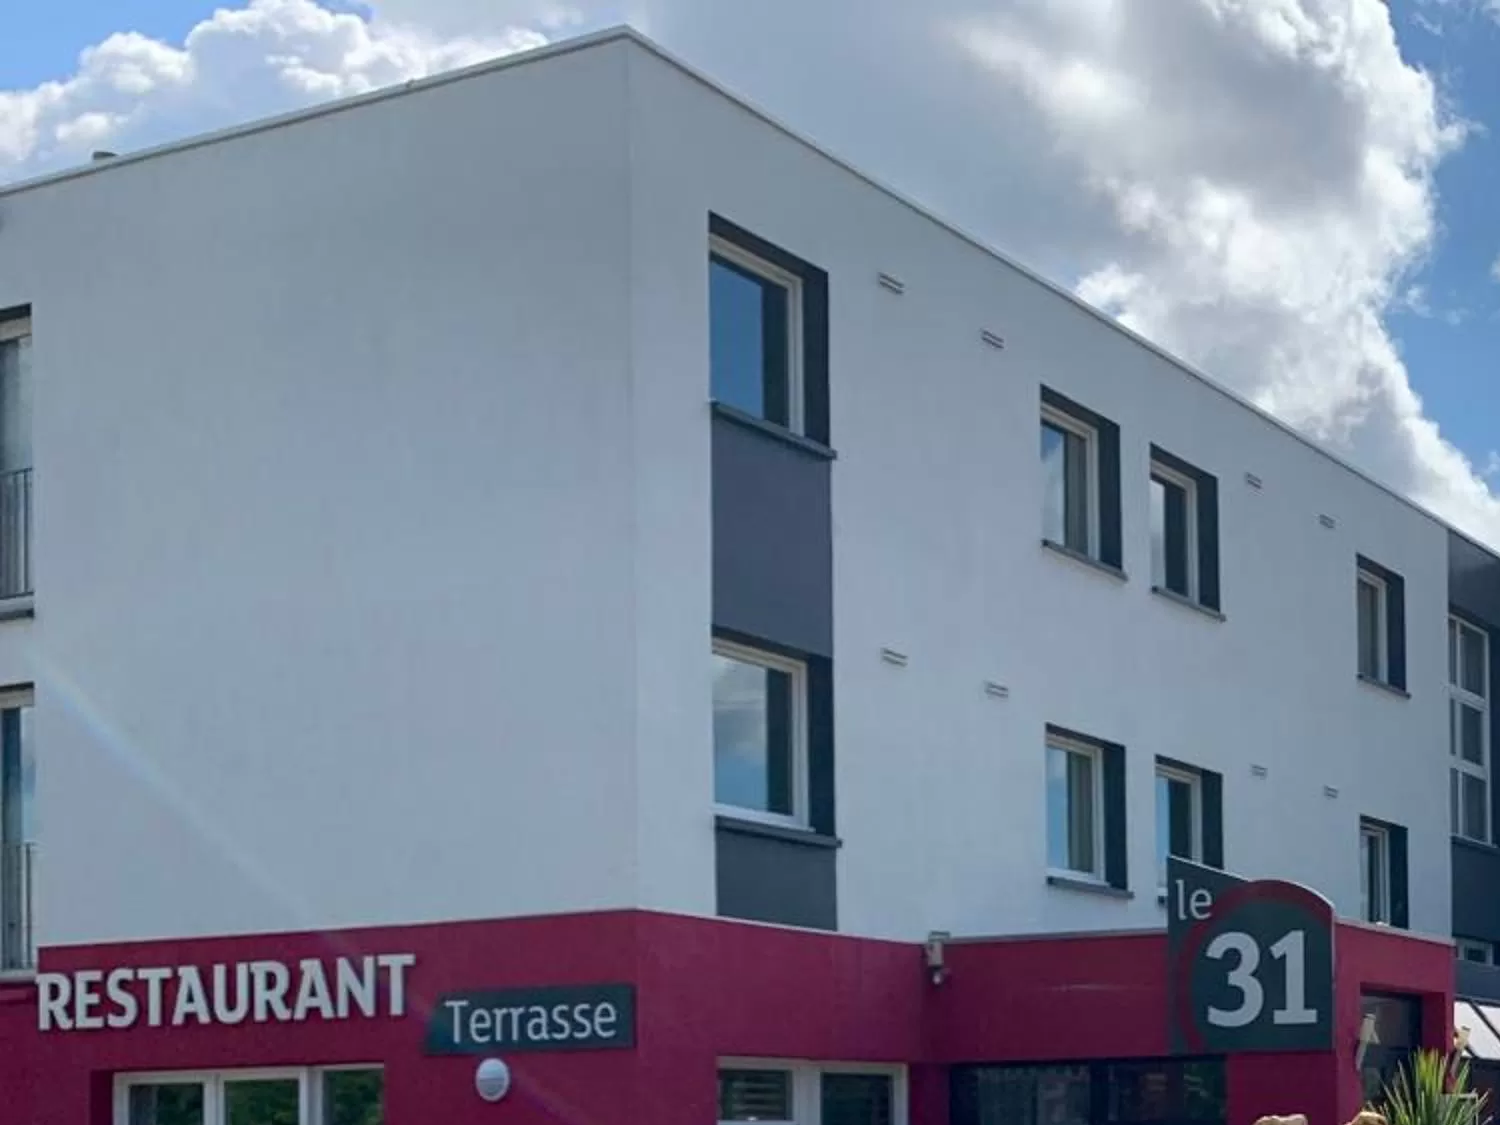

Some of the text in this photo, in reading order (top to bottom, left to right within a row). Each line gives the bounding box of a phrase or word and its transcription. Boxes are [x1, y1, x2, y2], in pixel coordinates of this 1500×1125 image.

[1175, 879, 1213, 921] le
[35, 953, 416, 1031] RESTAURANT
[1207, 930, 1317, 1028] 31
[444, 999, 618, 1045] Terrasse
